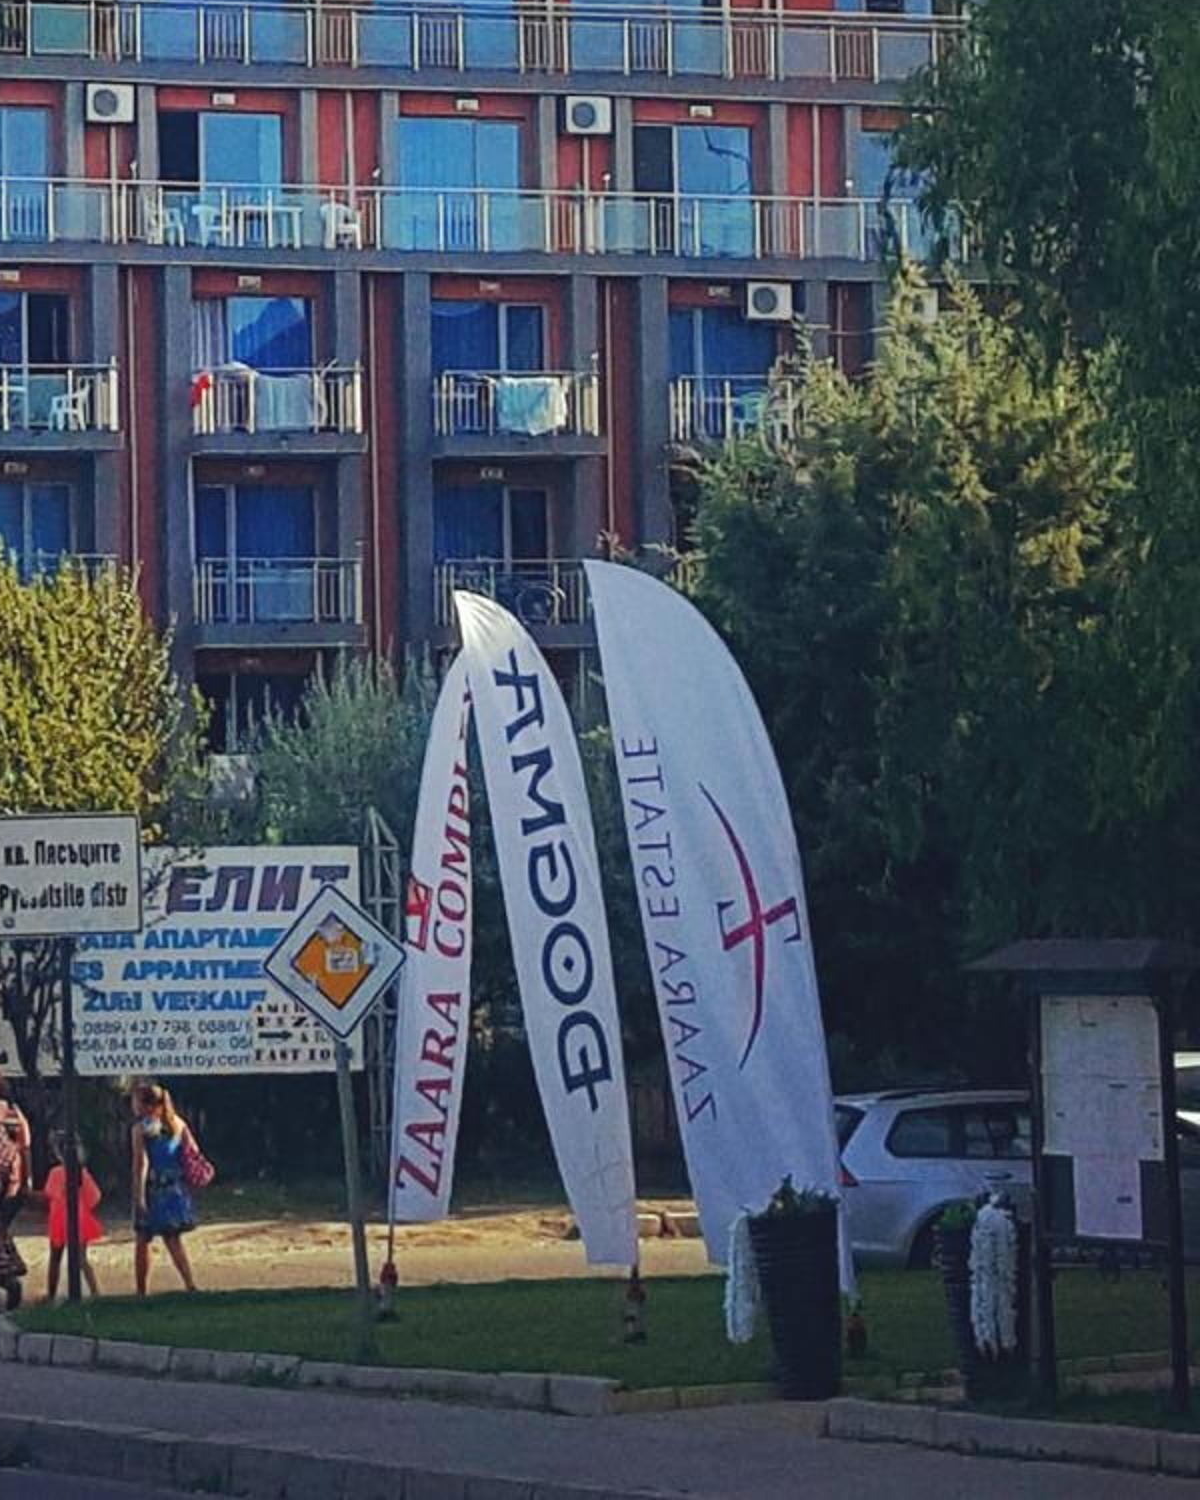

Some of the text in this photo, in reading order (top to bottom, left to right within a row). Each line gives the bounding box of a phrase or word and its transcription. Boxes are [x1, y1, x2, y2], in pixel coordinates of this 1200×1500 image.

[3, 840, 121, 867] кв. Пясъците
[395, 992, 462, 1197] ZAARA
